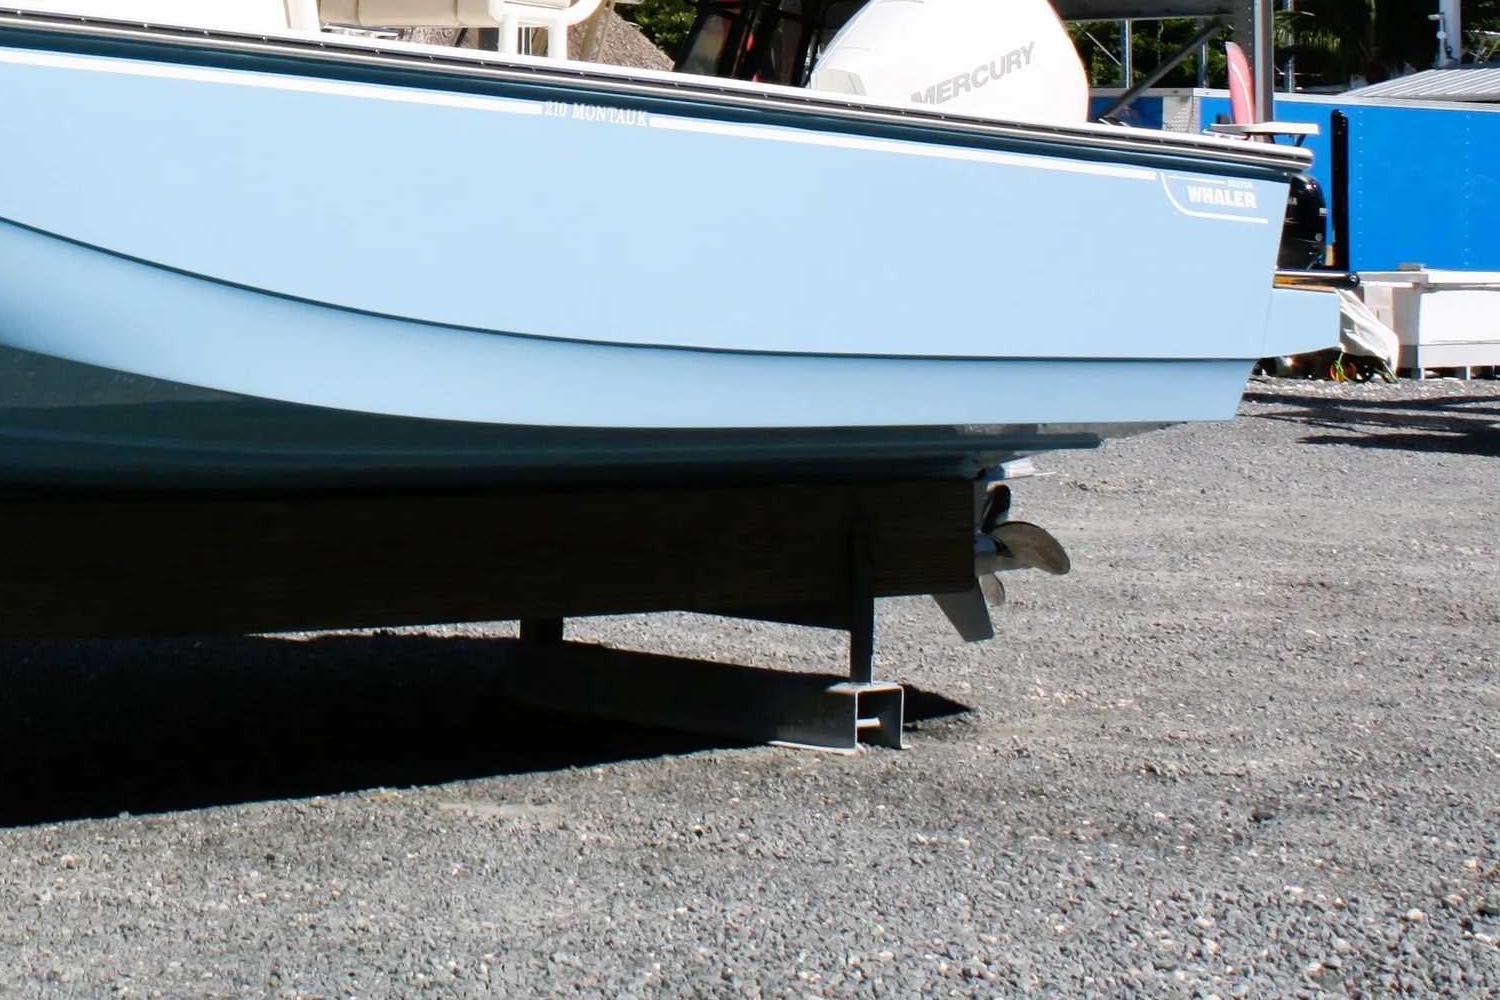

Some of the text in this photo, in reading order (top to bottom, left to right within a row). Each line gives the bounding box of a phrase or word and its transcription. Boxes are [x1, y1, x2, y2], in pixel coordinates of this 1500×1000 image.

[911, 41, 1036, 105] MERCURY
[544, 99, 648, 127] 210 MONTAUK
[1186, 184, 1257, 210] WHALER
[1227, 179, 1254, 189] BOSTON
